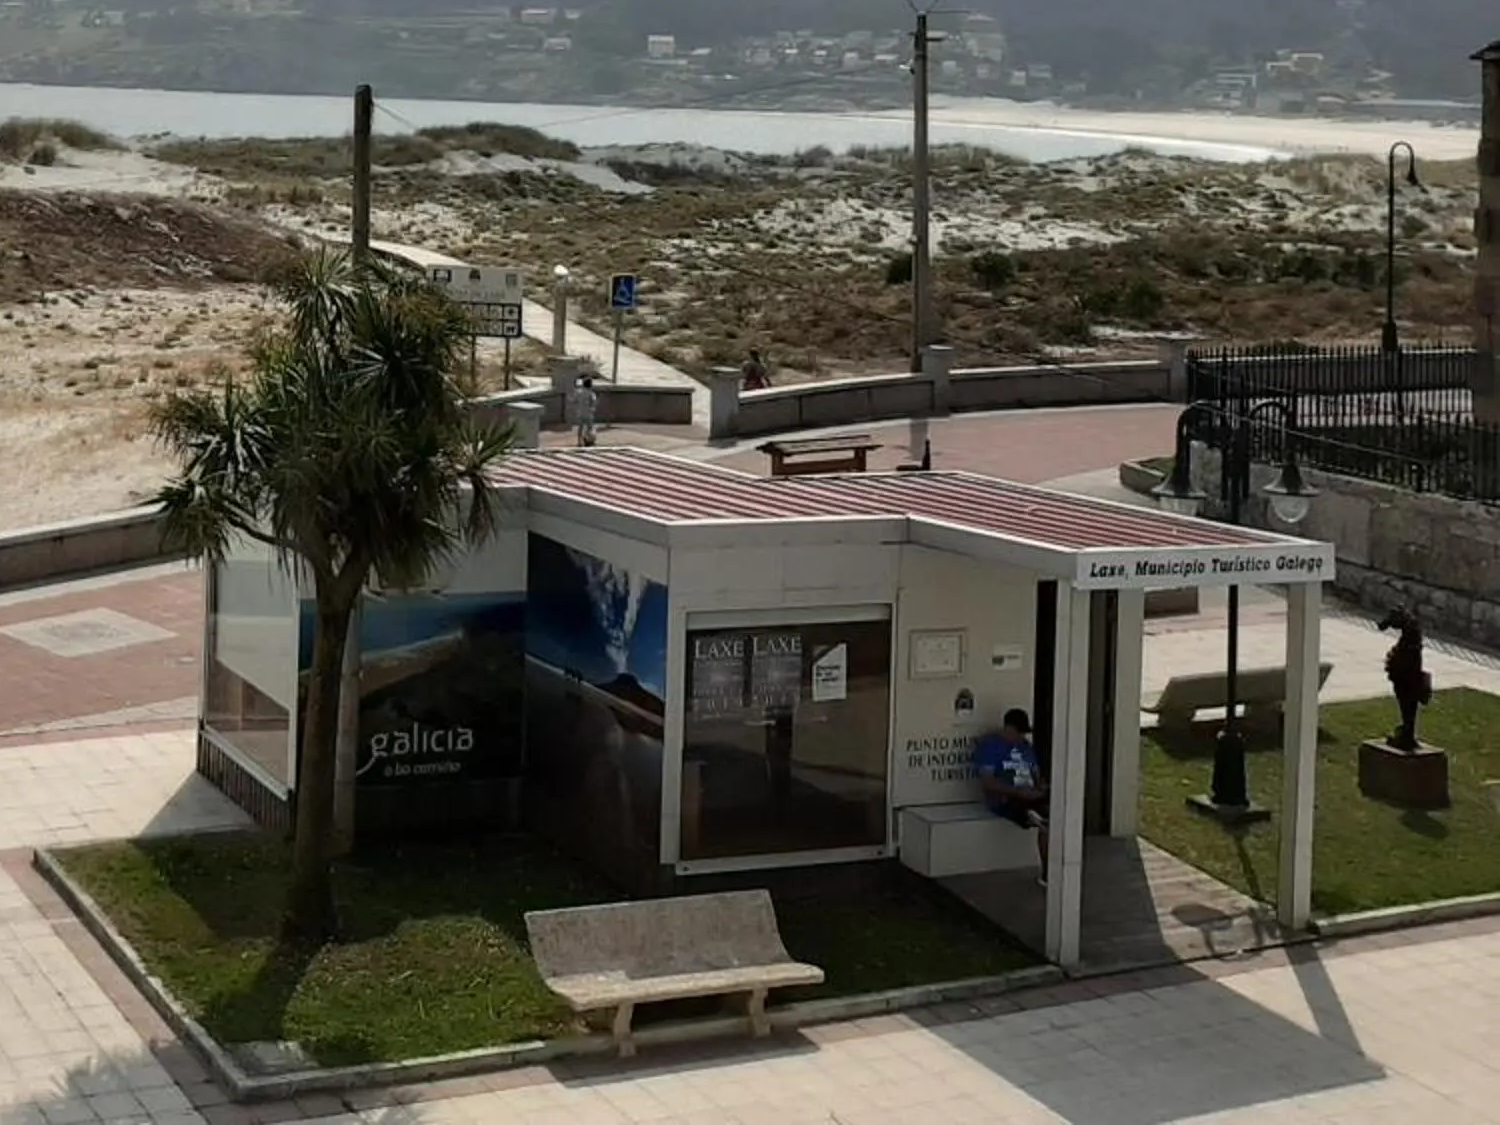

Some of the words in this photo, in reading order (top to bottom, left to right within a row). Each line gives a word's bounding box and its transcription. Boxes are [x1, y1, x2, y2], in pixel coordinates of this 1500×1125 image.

[1135, 557, 1205, 578] Municipio
[1211, 555, 1271, 574] Turístico
[1276, 555, 1324, 575] Galego
[694, 638, 744, 659] LAXE
[357, 721, 474, 775] galicia
[906, 737, 949, 752] PUNTO
